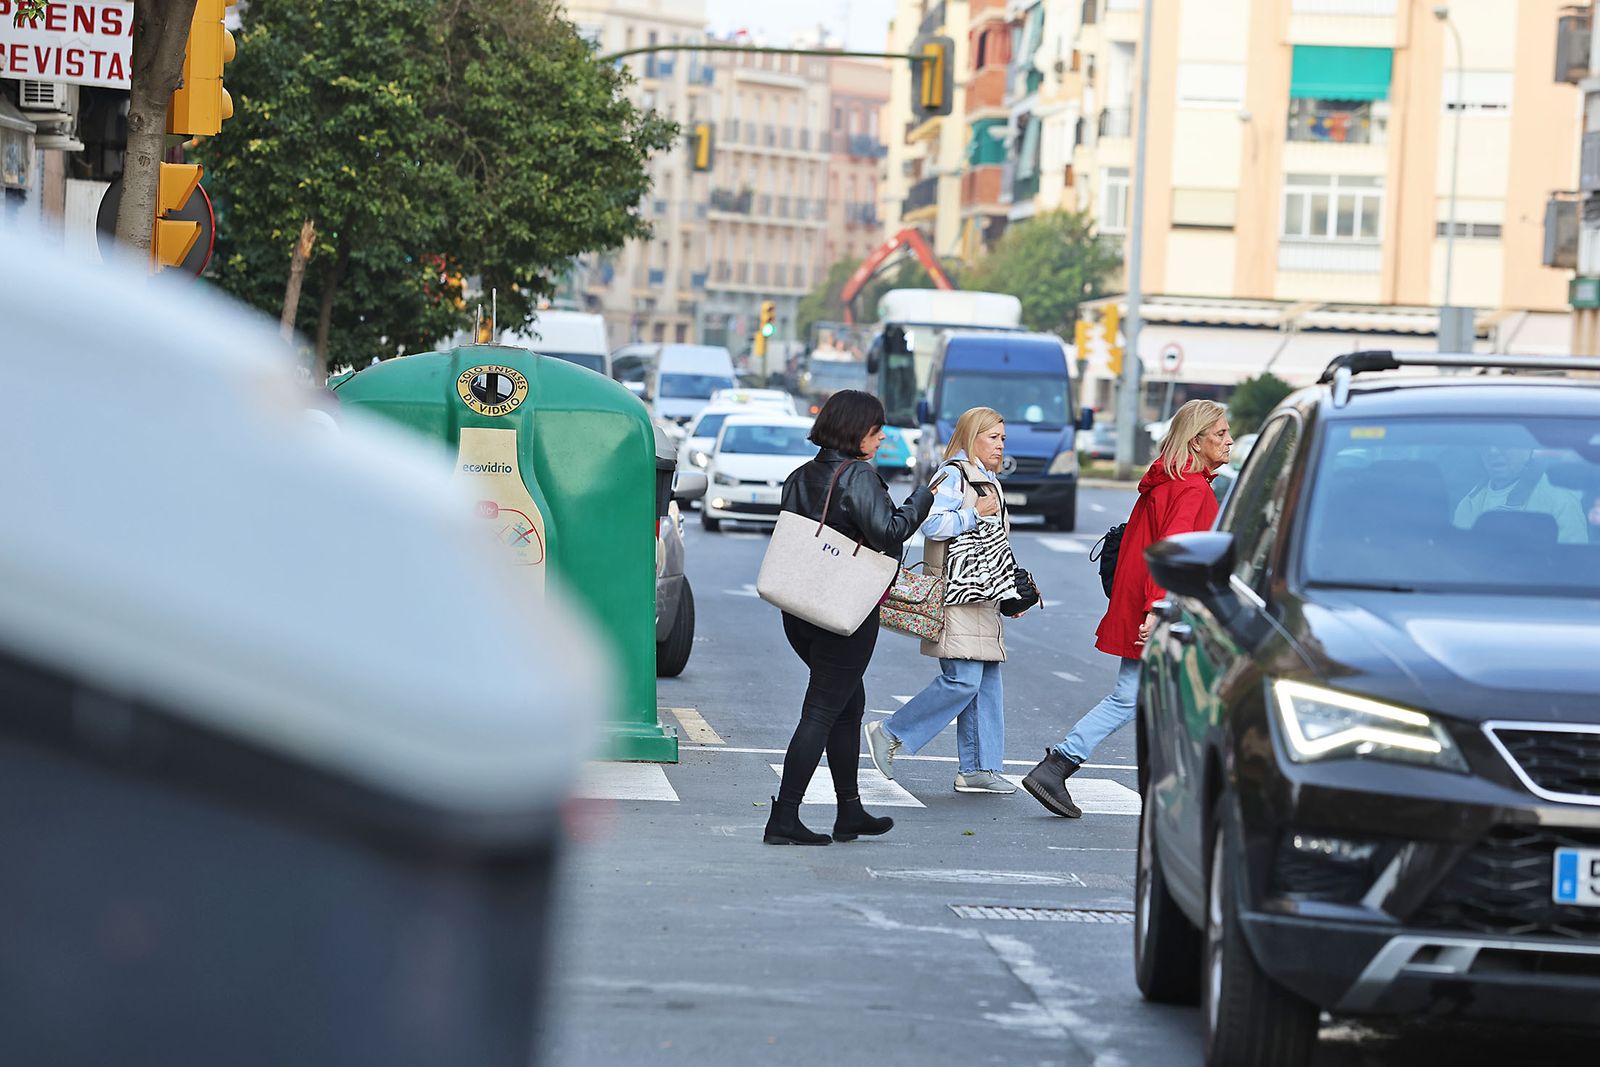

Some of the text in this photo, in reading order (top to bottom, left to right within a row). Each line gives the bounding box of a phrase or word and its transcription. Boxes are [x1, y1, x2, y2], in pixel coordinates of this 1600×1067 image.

[0, 44, 133, 81] EVISTA
[460, 366, 526, 390] SOLO ENVASES
[463, 393, 520, 415] DE VIDRIO
[463, 461, 512, 474] ecovidrio
[822, 543, 840, 556] PO
